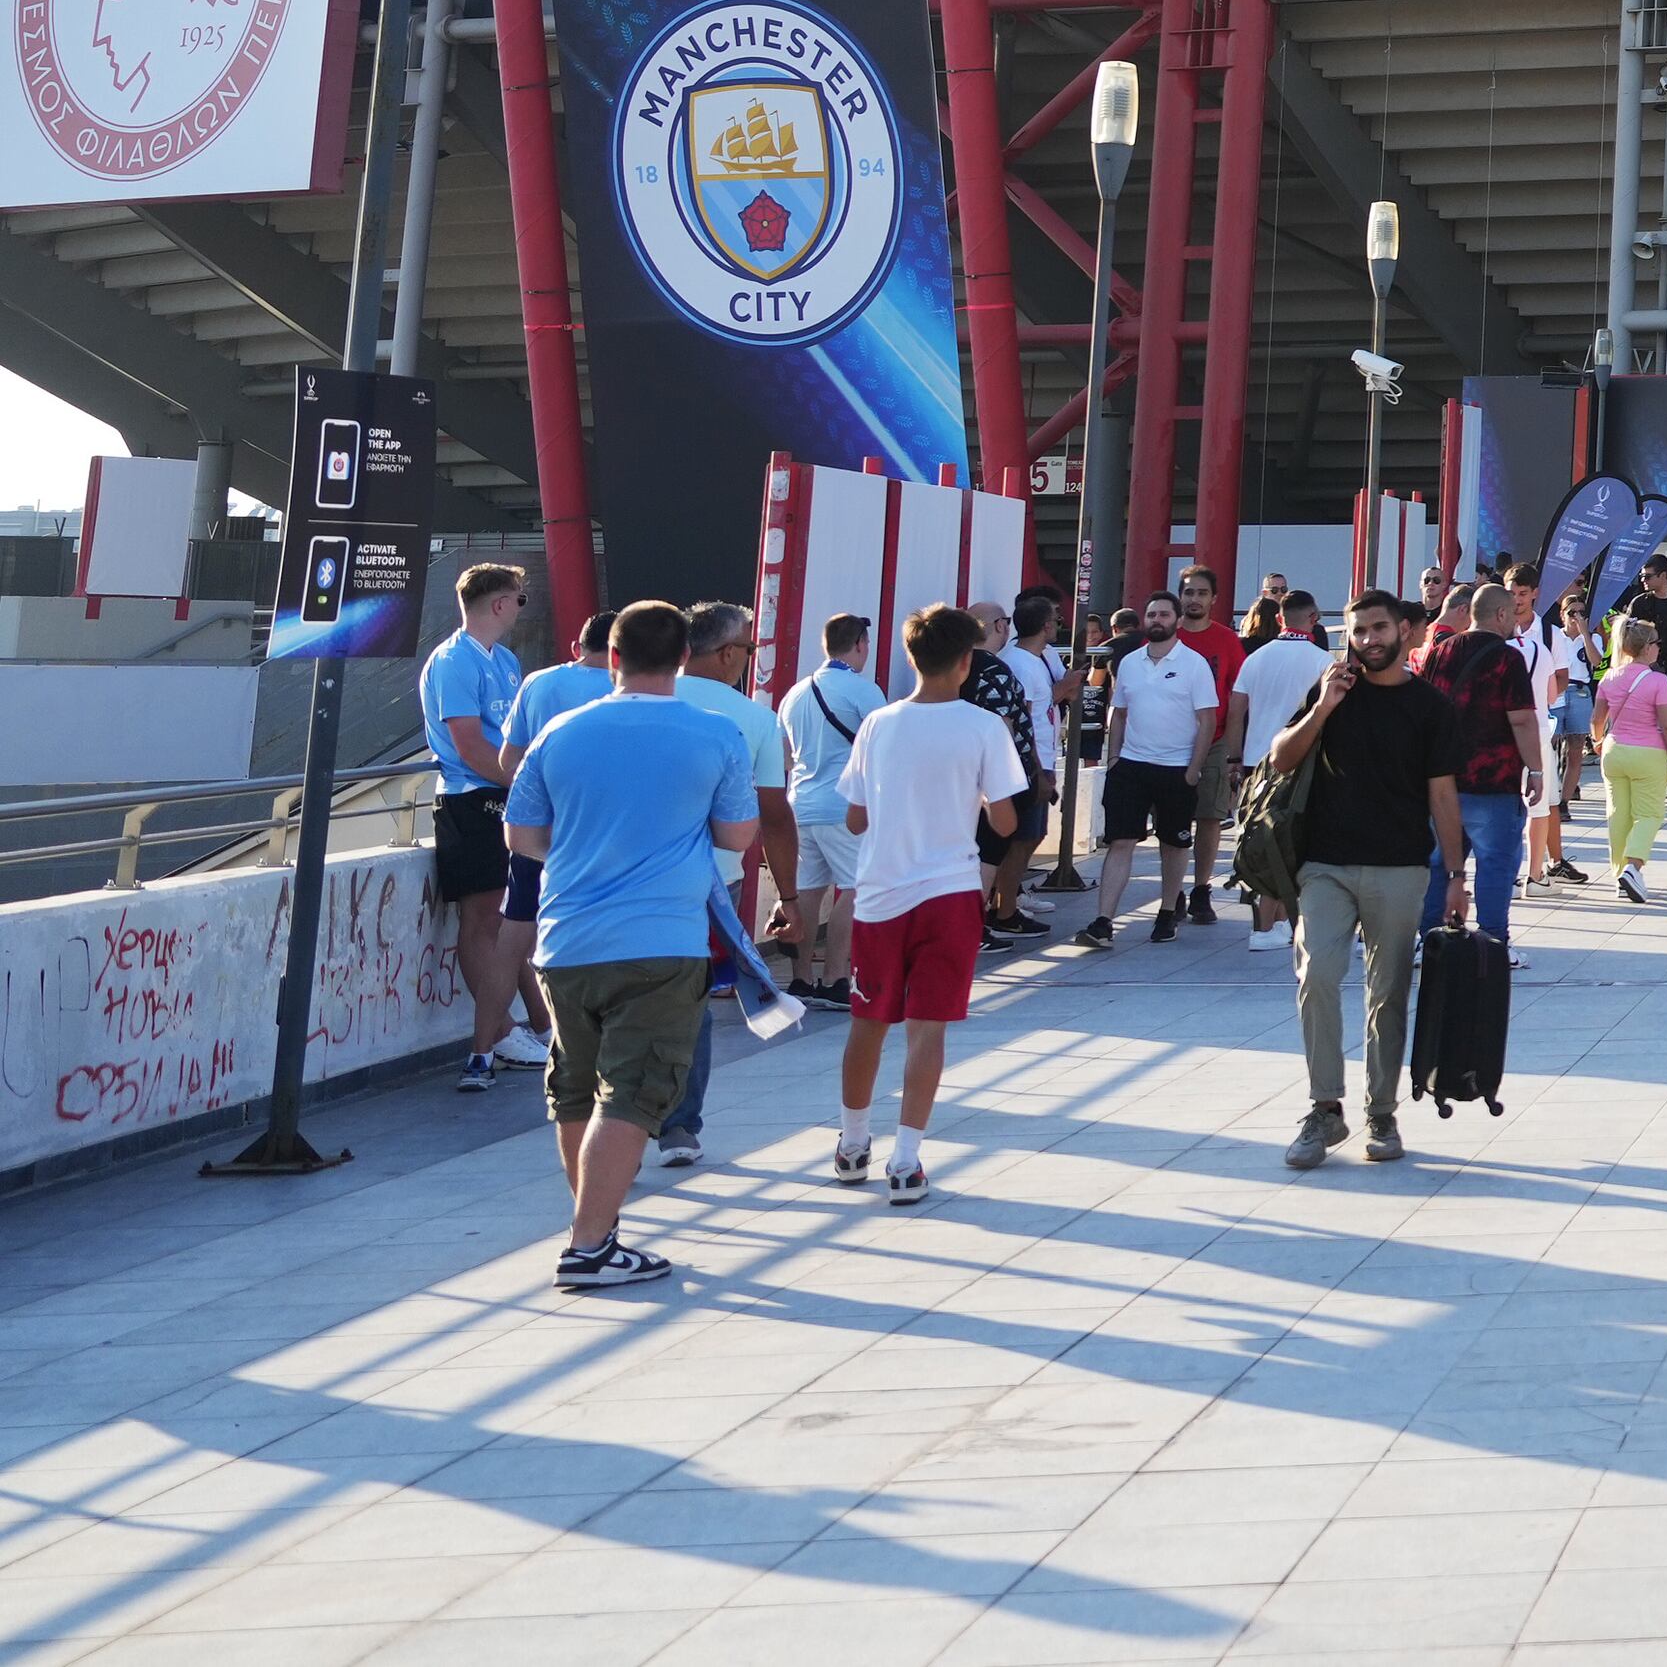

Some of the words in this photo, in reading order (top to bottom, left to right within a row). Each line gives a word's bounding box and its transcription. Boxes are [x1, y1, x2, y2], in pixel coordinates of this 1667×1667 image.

[180, 25, 226, 53] 1925
[639, 16, 868, 128] MANCHESTER
[76, 78, 243, 170] ΦΙΛΑΘΛΩΝ
[635, 164, 659, 184] 18
[858, 158, 885, 178] 94
[729, 291, 811, 322] CITY
[368, 428, 391, 439] OPEN
[368, 439, 383, 449] THE
[385, 441, 401, 450] APP
[357, 544, 397, 555] ACTIVATE
[356, 555, 405, 566] BLUETOOTH
[364, 580, 406, 589] BLUETOOTH
